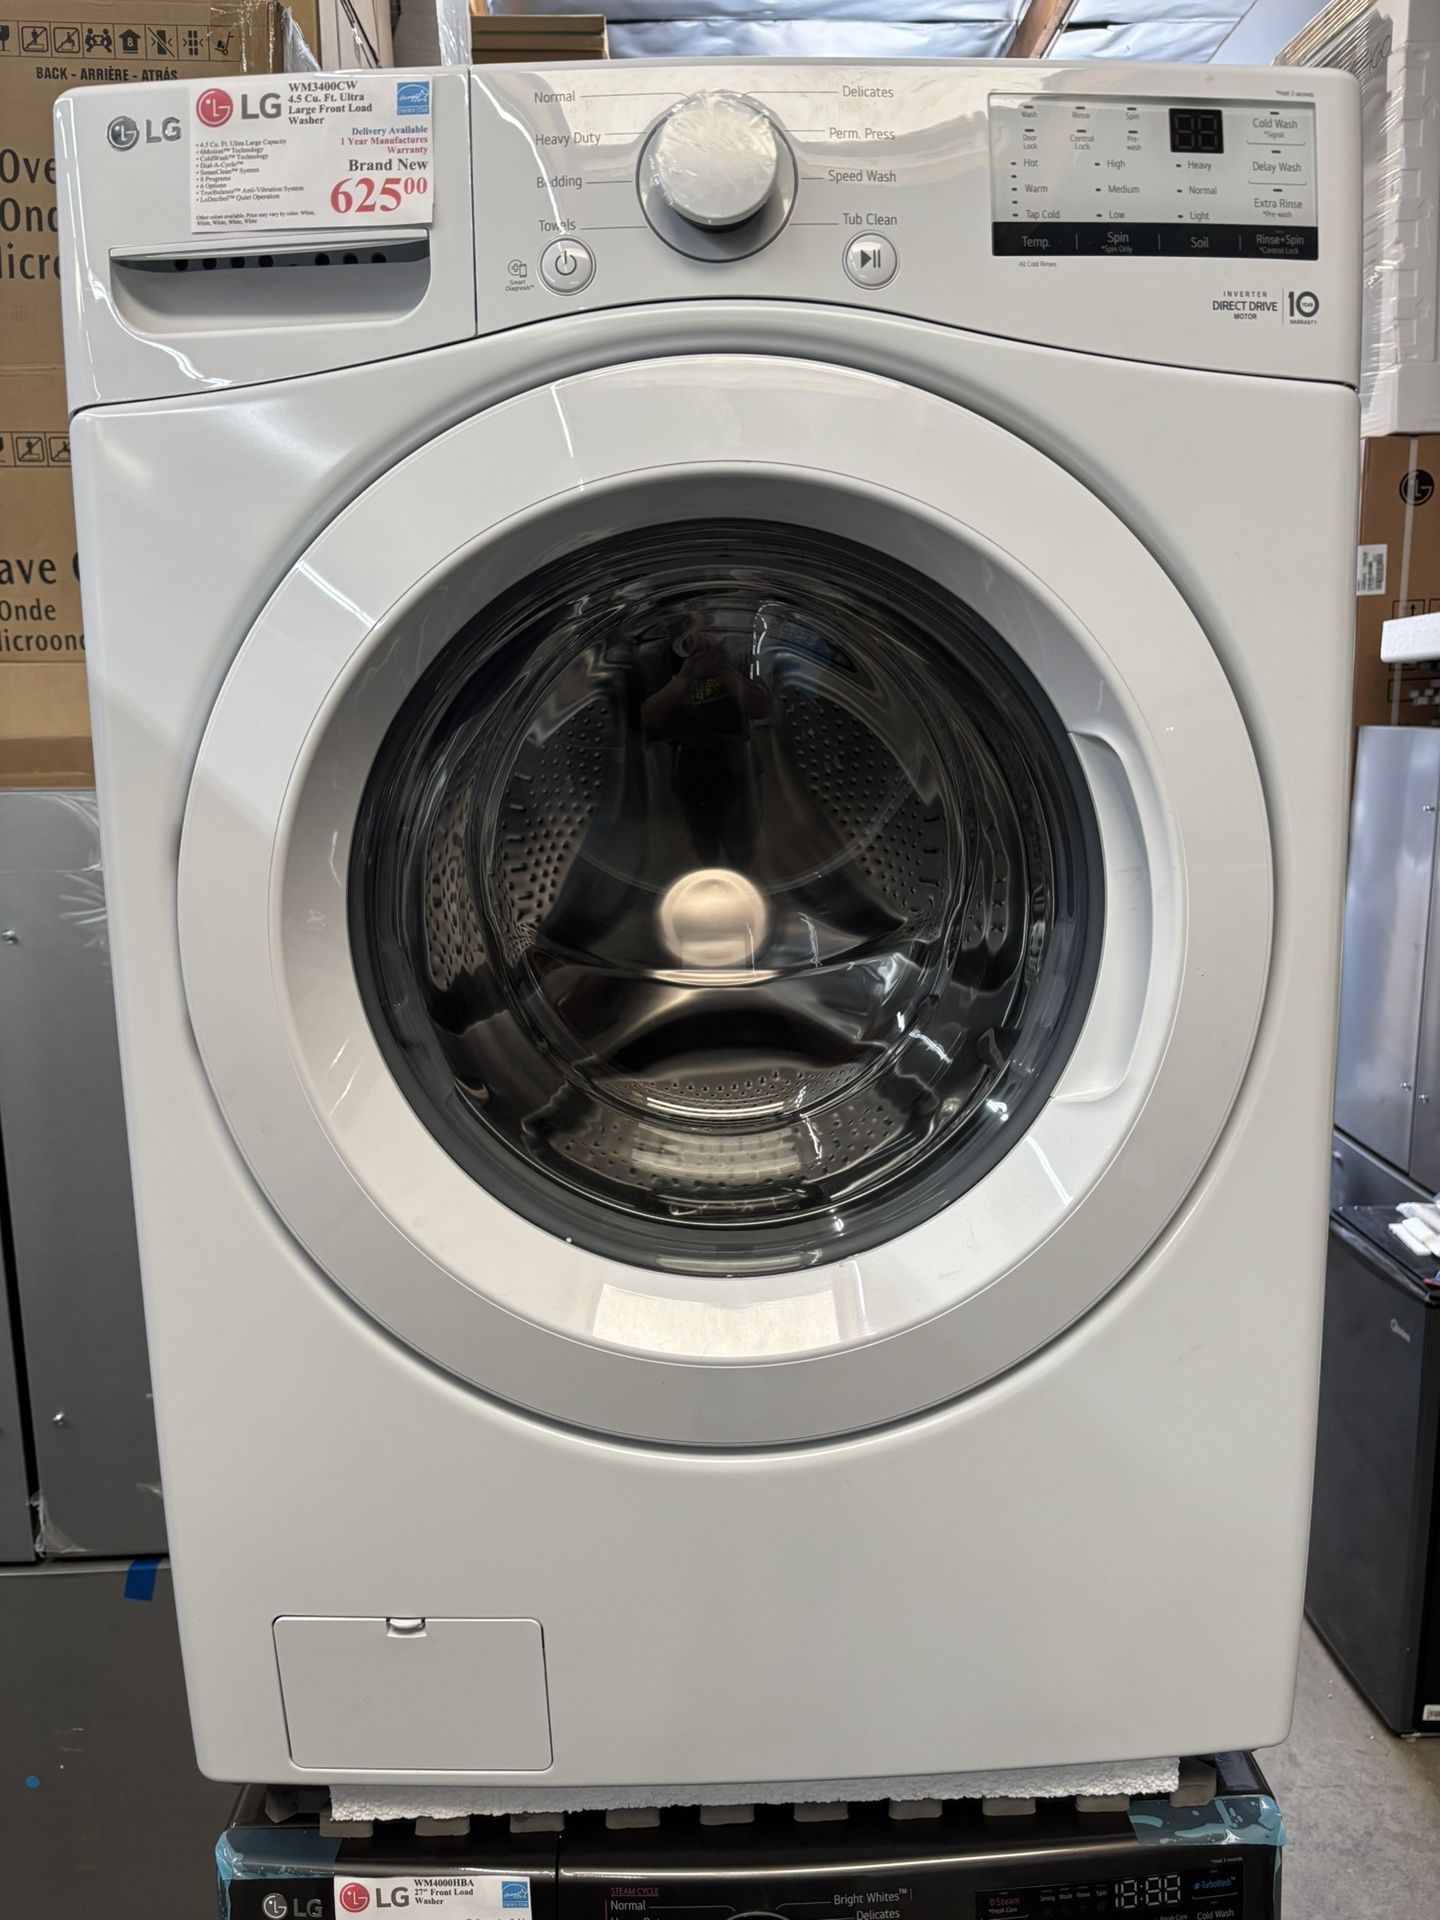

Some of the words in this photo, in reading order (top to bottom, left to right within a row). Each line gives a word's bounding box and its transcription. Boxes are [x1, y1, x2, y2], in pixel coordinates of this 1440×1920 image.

[36, 66, 68, 80] BACK
[80, 65, 129, 82] ARRIÈRE
[142, 66, 178, 81] ATRÁS
[288, 80, 358, 92] WM3400CW
[842, 85, 894, 98] Delicates
[288, 94, 302, 103] 4.5
[304, 94, 321, 103] Cu.
[324, 93, 338, 102] Ft.
[341, 92, 364, 102] Ultra
[534, 91, 576, 104] Normal
[241, 93, 281, 120] LG
[288, 105, 316, 116] Large
[318, 104, 345, 114] Front
[348, 103, 372, 112] Load
[288, 116, 324, 124] Washer
[1125, 112, 1140, 120] Spin
[1252, 118, 1272, 128] Cold
[1275, 118, 1298, 129] Wash
[146, 117, 181, 143] LG
[352, 127, 386, 136] Delivery
[389, 126, 428, 134] Available
[829, 127, 861, 140] Perm.
[864, 128, 896, 140] Press
[348, 137, 368, 145] Year
[370, 136, 428, 145] Manufactures
[536, 134, 570, 146] Heavy
[574, 132, 601, 146] Duty
[1022, 134, 1037, 142] Door
[1070, 134, 1094, 142] Control
[387, 146, 428, 155] Warranty
[1024, 142, 1038, 150] Lock
[1074, 142, 1090, 150] Lock
[349, 158, 392, 172] Brand
[398, 158, 428, 170] New
[1024, 158, 1038, 167] Hot
[1106, 160, 1126, 170] High
[1188, 160, 1212, 171] Heavy
[1252, 161, 1276, 174] Delay
[1278, 162, 1302, 172] Wash
[828, 170, 862, 184] Speed
[866, 170, 896, 182] Wash
[1024, 184, 1048, 193] Warm
[1108, 184, 1140, 193] Medium
[1189, 186, 1218, 195] Normal
[1254, 198, 1277, 208] Extra
[1279, 198, 1303, 209] Rinse
[842, 212, 862, 226] Tub
[866, 212, 898, 226] Clean
[1026, 210, 1040, 220] Tap
[1042, 209, 1060, 218] Cold
[1109, 210, 1125, 219] Low
[1190, 211, 1210, 222] Light
[1022, 236, 1051, 250] Temp.
[1107, 231, 1129, 246] Spin
[1190, 236, 1210, 248] Soil
[1256, 234, 1304, 247] Rinse+Spin
[1223, 290, 1268, 298] INVERTER
[1212, 300, 1248, 311] DIRECT
[1248, 301, 1278, 312] DRIVE
[0, 598, 56, 621] Onde
[414, 1878, 474, 1888] WM4000HBA
[376, 1887, 410, 1908] LG
[414, 1888, 428, 1896] 27"
[430, 1888, 456, 1896] Front
[458, 1888, 474, 1896] Load
[610, 1888, 635, 1896] STEAM
[636, 1888, 660, 1896] CYCLE
[414, 1897, 444, 1906] Washer
[610, 1900, 646, 1910] Normal
[834, 1893, 864, 1907] Bright
[294, 1900, 324, 1918] LG
[856, 1909, 900, 1920] Delicates
[1196, 1910, 1214, 1920] Cold
[1214, 1908, 1234, 1919] Wash
